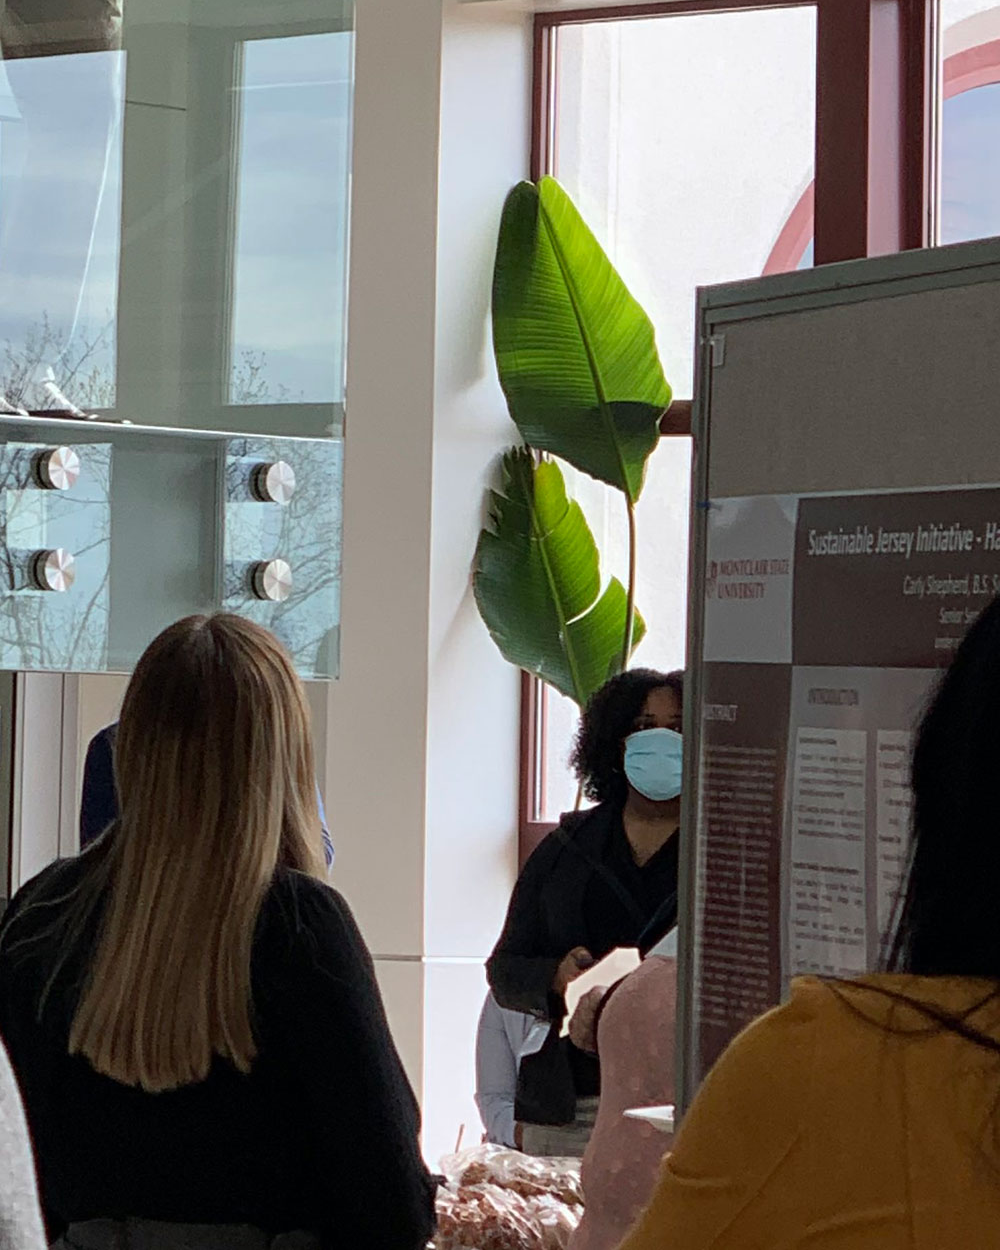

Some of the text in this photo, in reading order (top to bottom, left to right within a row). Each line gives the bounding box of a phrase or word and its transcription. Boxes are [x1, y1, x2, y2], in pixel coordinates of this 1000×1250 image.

[808, 525, 873, 555] Sustainable
[875, 526, 914, 559] Jersey
[916, 523, 973, 552] Initiative
[717, 582, 765, 599] UNIVERSITY
